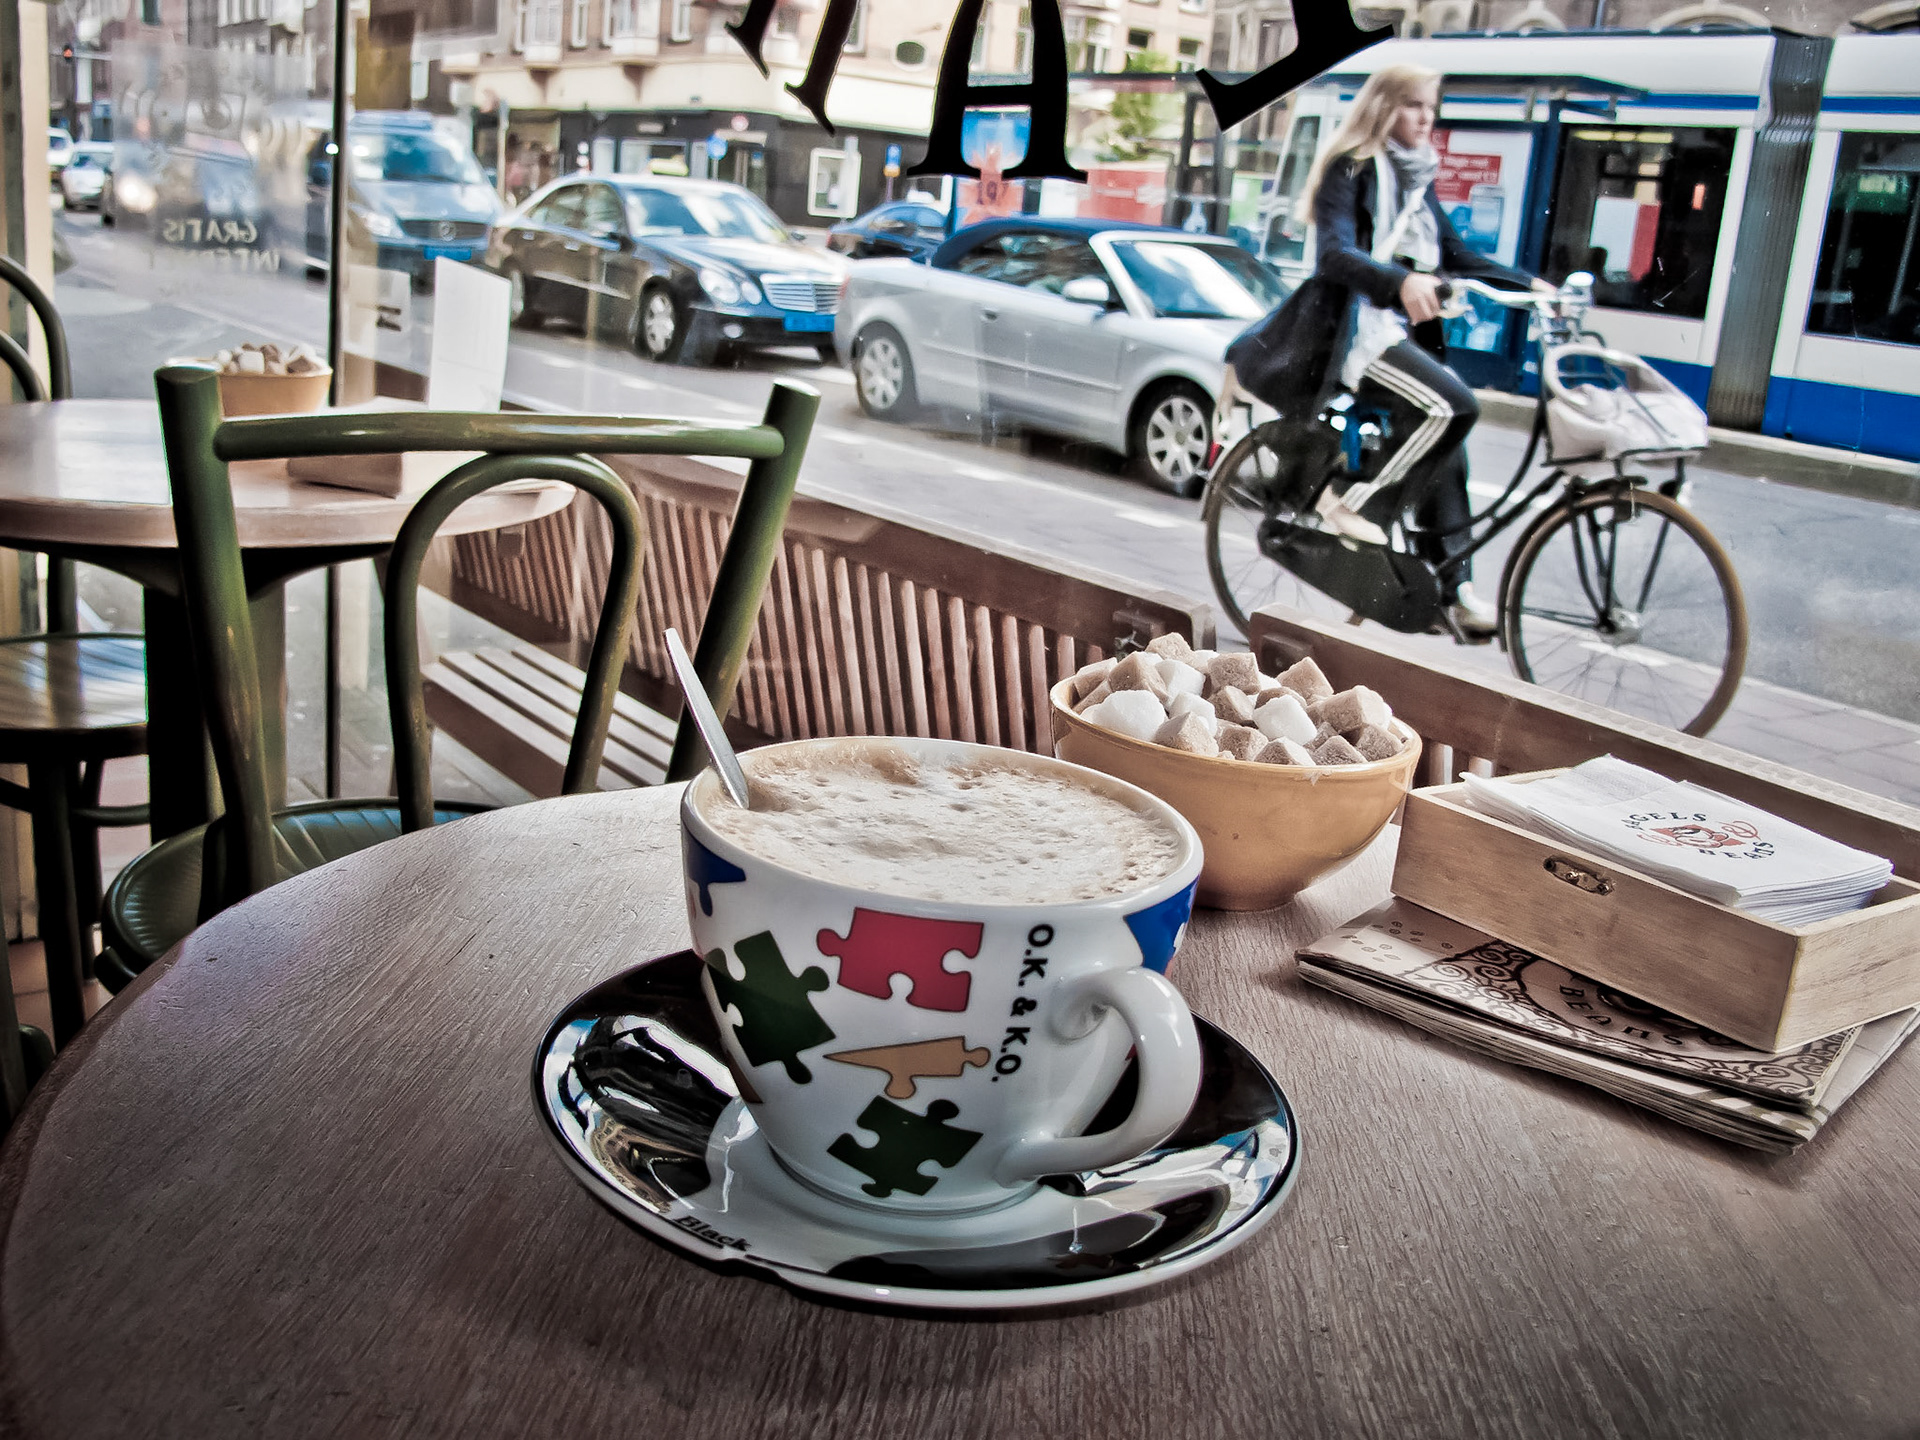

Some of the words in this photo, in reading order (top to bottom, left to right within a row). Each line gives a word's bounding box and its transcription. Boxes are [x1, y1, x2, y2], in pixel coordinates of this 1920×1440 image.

[1018, 923, 1054, 987] O.K.
[1010, 996, 1038, 1018] &
[1559, 984, 1684, 1046] BEANS
[991, 1026, 1031, 1083] K.O.
[673, 1215, 752, 1251] Black
